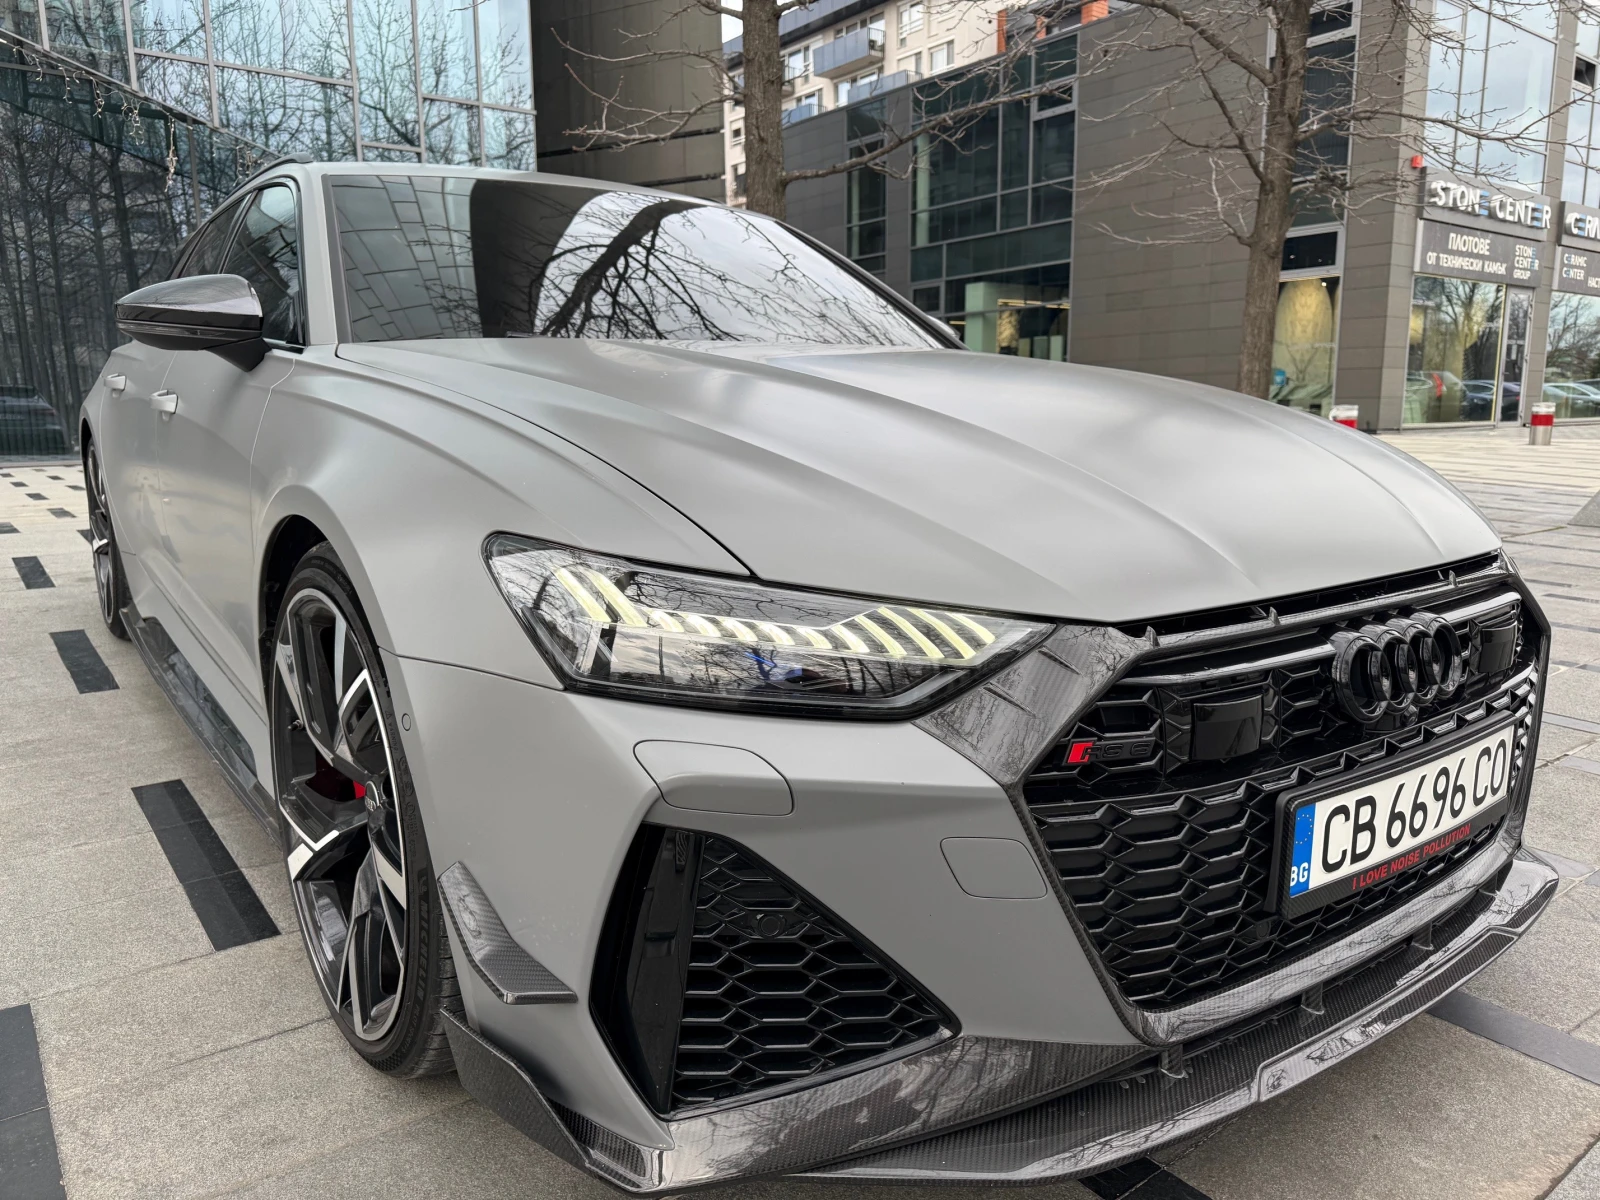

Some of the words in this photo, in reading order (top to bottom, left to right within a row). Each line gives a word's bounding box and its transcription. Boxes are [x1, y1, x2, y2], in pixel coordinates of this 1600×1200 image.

[1430, 181, 1490, 216] STONE
[1491, 195, 1551, 229] CENTER
[1448, 232, 1491, 256] ПЛОТОВЕ
[1515, 244, 1536, 259] STONE
[1426, 251, 1438, 266] ОТ
[1439, 253, 1483, 272] ТЕХНИЧЕСКИ
[1483, 260, 1507, 276] КАМЪК
[1512, 268, 1531, 280] GROUP
[1513, 256, 1540, 271] CENTER
[1562, 267, 1585, 281] CENTER
[1352, 877, 1358, 890] I
[1359, 862, 1394, 887] LOVE
[1390, 851, 1421, 874] NOISE
[1422, 823, 1471, 858] POLLUTION
[1290, 861, 1310, 886] BG
[416, 901, 430, 1001] MICHELIN
